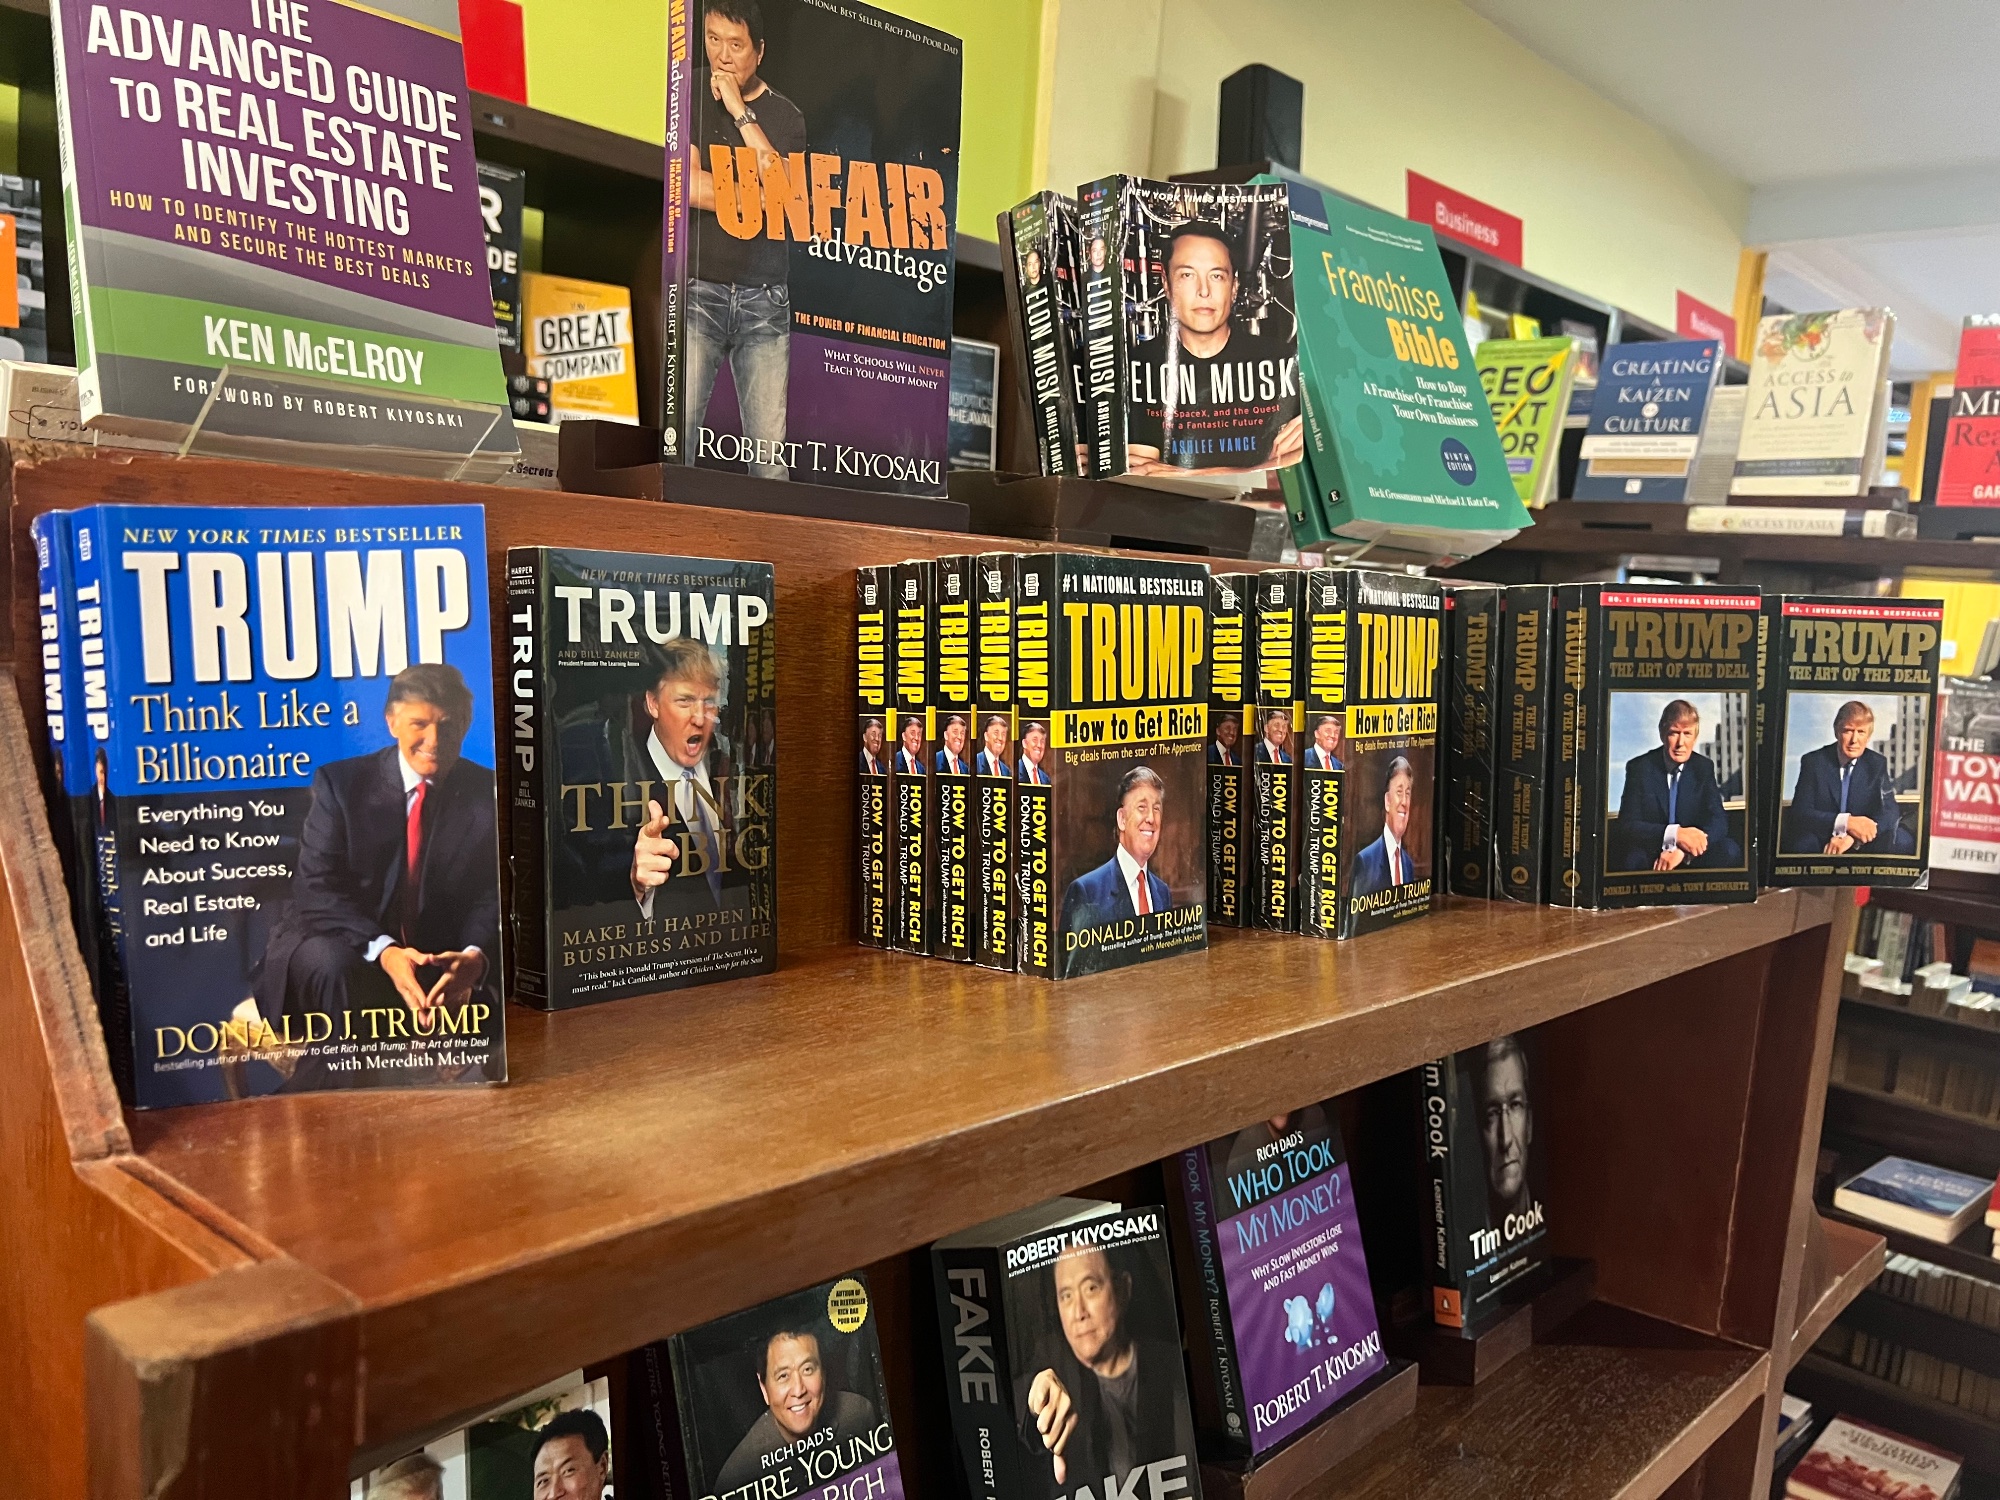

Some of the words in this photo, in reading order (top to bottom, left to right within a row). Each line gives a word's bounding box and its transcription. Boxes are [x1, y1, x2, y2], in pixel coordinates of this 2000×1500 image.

[251, 0, 312, 43] THE
[88, 5, 334, 104] ADVANCED
[347, 66, 461, 141] GUIDE
[110, 77, 161, 122] TO
[174, 77, 294, 152] REAL
[305, 109, 454, 193] ESTATE
[181, 138, 409, 236] INVESTING
[709, 144, 948, 251] UNFAIR
[1128, 187, 1152, 200] NEW
[1152, 190, 1181, 203] YORK
[1184, 193, 1214, 204] TIMES
[1216, 193, 1278, 204] BESTSELLER
[110, 189, 153, 212] HOW
[161, 197, 185, 217] TO
[194, 201, 278, 235] IDENTIFY
[286, 221, 317, 243] THE
[325, 229, 395, 260] HOTTEST
[403, 247, 473, 276] MARKETS
[1435, 201, 1500, 247] Business
[808, 228, 948, 292] advantage
[1086, 276, 1112, 331] ELON
[1321, 251, 1444, 322] Franchise
[541, 311, 621, 351] GREAT
[795, 312, 811, 326] THE
[813, 315, 842, 331] POWER
[845, 321, 855, 333] OF
[857, 324, 900, 342] FINANCIAL
[903, 332, 946, 350] EDUCATION
[1025, 286, 1053, 341] ELON
[204, 315, 275, 365] KEN
[285, 330, 425, 387] McELROY
[543, 351, 622, 380] COMPANY
[1385, 317, 1459, 370] Bible
[1032, 343, 1061, 405] MUSK
[1088, 337, 1115, 399] MUSK
[1132, 360, 1196, 405] ELON
[1211, 357, 1297, 405] MUSK
[1416, 376, 1436, 391] How
[1438, 380, 1447, 393] to
[1448, 381, 1467, 396] Buy
[1478, 364, 1555, 396] CEO
[1612, 358, 1711, 376] CREATING
[1651, 376, 1660, 387] A
[1764, 369, 1836, 387] ACCESS
[1840, 369, 1853, 383] to
[173, 376, 274, 409] FOREWORD
[284, 396, 305, 413] BY
[314, 399, 378, 420] ROBERT
[387, 407, 464, 428] KIYOSAKI
[1363, 382, 1372, 394] A
[1372, 383, 1413, 402] Franchise
[1414, 392, 1427, 406] Or
[1427, 393, 1473, 411] Franchise
[1618, 386, 1691, 403] KAIZEN
[1754, 385, 1855, 420] ASIA
[1098, 400, 1111, 443] ASHLEE
[1604, 415, 1692, 433] CULTURE
[1099, 444, 1111, 473] VANCE
[1172, 437, 1213, 455] ASHLEE
[1219, 436, 1256, 454] VANCE
[1443, 451, 1470, 462] NINTH
[1447, 461, 1473, 472] EDITION
[516, 462, 553, 478] Secrets
[122, 527, 178, 545] NEW
[188, 527, 250, 545] YORK
[259, 527, 327, 544] TIMES
[335, 525, 463, 543] BESTSELLER
[511, 566, 533, 575] HARPER
[1062, 574, 1078, 593] #1
[1082, 575, 1136, 595] NATIONAL
[1139, 577, 1204, 597] BESTSELLER
[122, 547, 470, 684] TRUMP
[555, 586, 769, 646] TRUMP
[1608, 610, 1753, 660] TRUMP
[77, 579, 109, 740] TRUMP
[939, 600, 969, 702] TRUMP
[1018, 601, 1049, 708] TRUMP
[1063, 602, 1204, 703] TRUMP
[1357, 612, 1439, 700] TRUMP
[1789, 619, 1937, 666] TRUMP
[512, 605, 534, 772] TRUMP
[1609, 661, 1634, 677] THE
[1637, 662, 1662, 678] ART
[1666, 663, 1683, 678] OF
[1687, 663, 1713, 679] THE
[1716, 663, 1750, 679] DEAL
[130, 690, 244, 733] Think
[258, 690, 331, 729] Like
[343, 700, 359, 727] a
[1065, 712, 1104, 744] How
[1111, 713, 1128, 741] to
[1134, 709, 1163, 739] Get
[1168, 707, 1201, 736] Rich
[136, 742, 311, 785] Billionaire
[1948, 737, 1985, 753] THE
[138, 803, 243, 826] Everything
[249, 800, 285, 818] You
[561, 774, 770, 833] THINK
[992, 787, 1006, 833] HOW
[142, 866, 206, 886] About
[211, 861, 293, 881] Success,
[675, 824, 771, 878] BIG
[992, 838, 1006, 864] TO
[1951, 847, 1999, 863] JEFFREY
[992, 868, 1006, 905] GET
[563, 924, 626, 947] MAKE
[635, 920, 657, 937] IT
[664, 908, 744, 933] HAPPEN
[751, 906, 770, 921] IN
[992, 909, 1006, 954] RICH
[1066, 920, 1135, 951] DONALD
[1138, 917, 1149, 937] J.
[1155, 905, 1203, 931] TRUMP
[154, 1011, 332, 1059] DONALD
[339, 1010, 359, 1042] J.
[361, 1003, 490, 1039] TRUMP
[327, 1054, 361, 1072] with
[365, 1052, 434, 1069] Meredith
[437, 1051, 490, 1067] McIver
[1256, 1142, 1279, 1163] RICH
[1280, 1130, 1304, 1153] DAD'S
[1427, 1095, 1448, 1158] Cook
[1228, 1162, 1284, 1209] WHO
[1283, 1138, 1336, 1183] TOOK
[1236, 1212, 1268, 1254] MY
[1269, 1173, 1341, 1239] MONEY?
[1469, 1227, 1500, 1260] Tim
[1504, 1201, 1544, 1241] Cook
[1006, 1233, 1069, 1269] ROBERT
[1071, 1214, 1158, 1249] KIYOSAKI
[947, 1268, 998, 1404] FAKE
[1253, 1377, 1310, 1432] ROBERT
[1310, 1365, 1327, 1393] T.
[1326, 1331, 1381, 1386] KIYOSAKI
[760, 1446, 794, 1469] RICH
[796, 1427, 834, 1454] DAD'S
[797, 1423, 893, 1486] YOUNG
